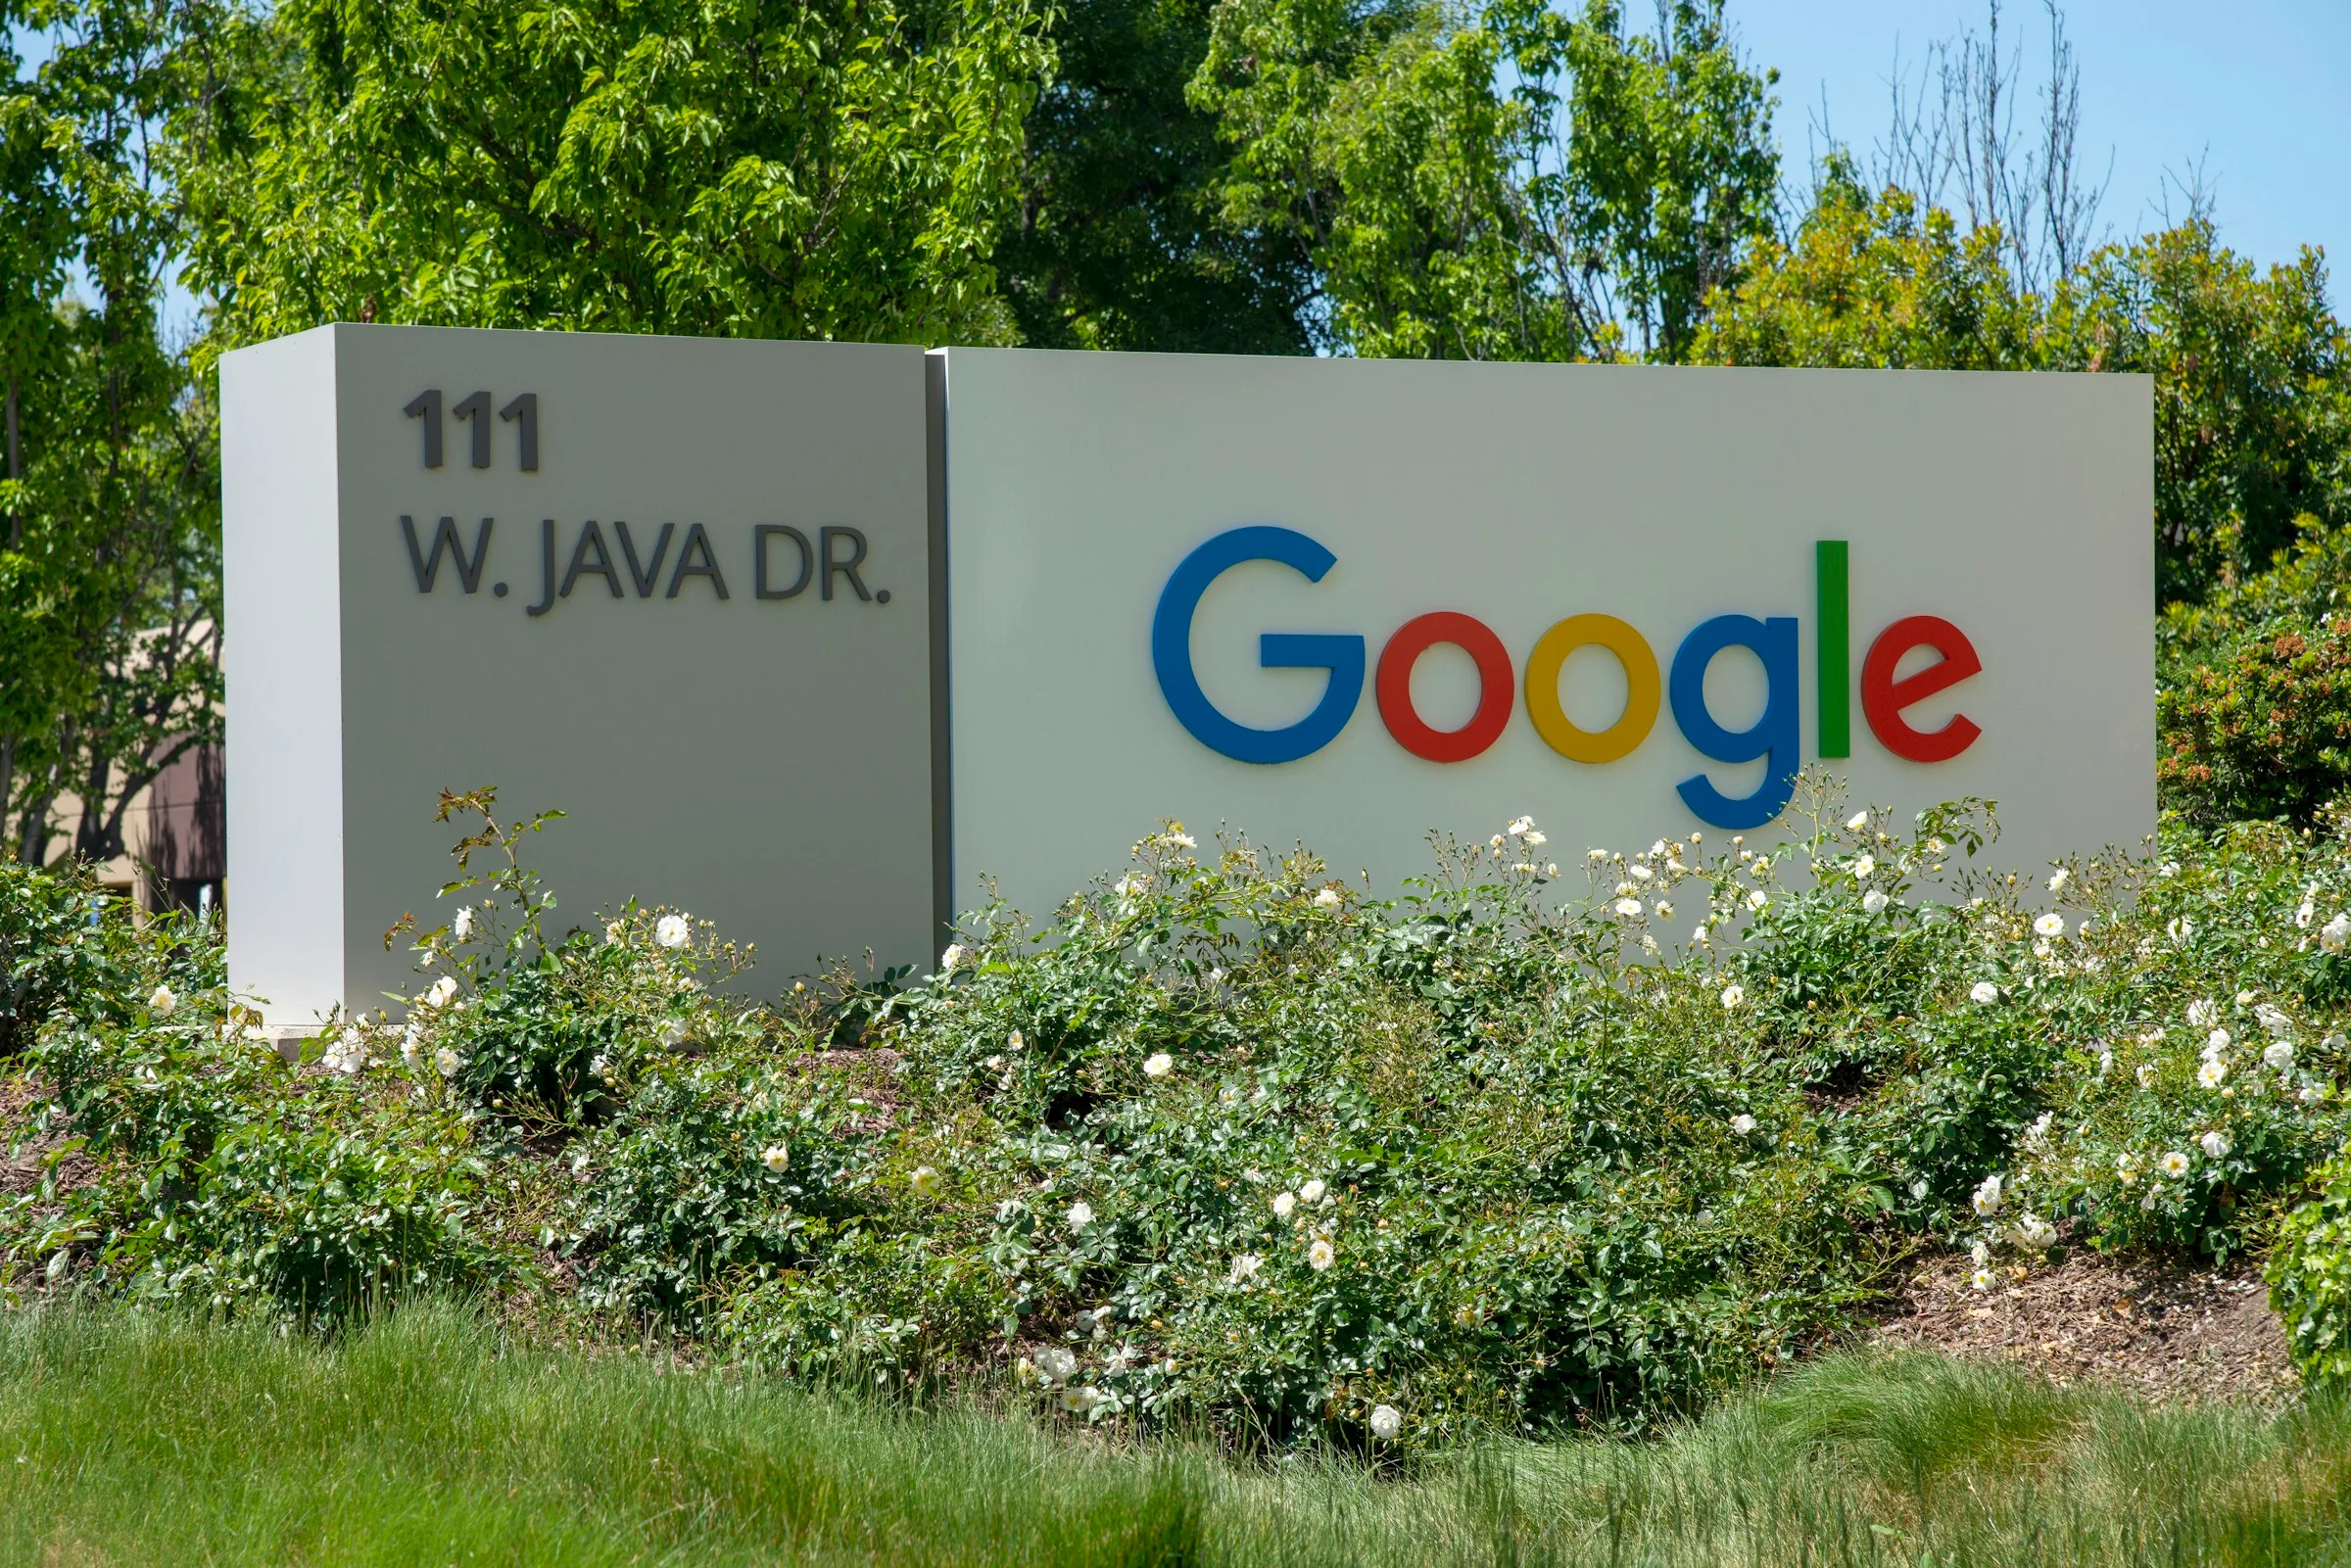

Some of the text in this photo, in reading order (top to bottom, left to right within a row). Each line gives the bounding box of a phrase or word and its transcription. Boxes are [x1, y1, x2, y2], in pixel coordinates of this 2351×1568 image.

[403, 389, 539, 472] 111
[400, 515, 891, 616] W. JAVA DR.
[1152, 525, 1983, 830] Google
